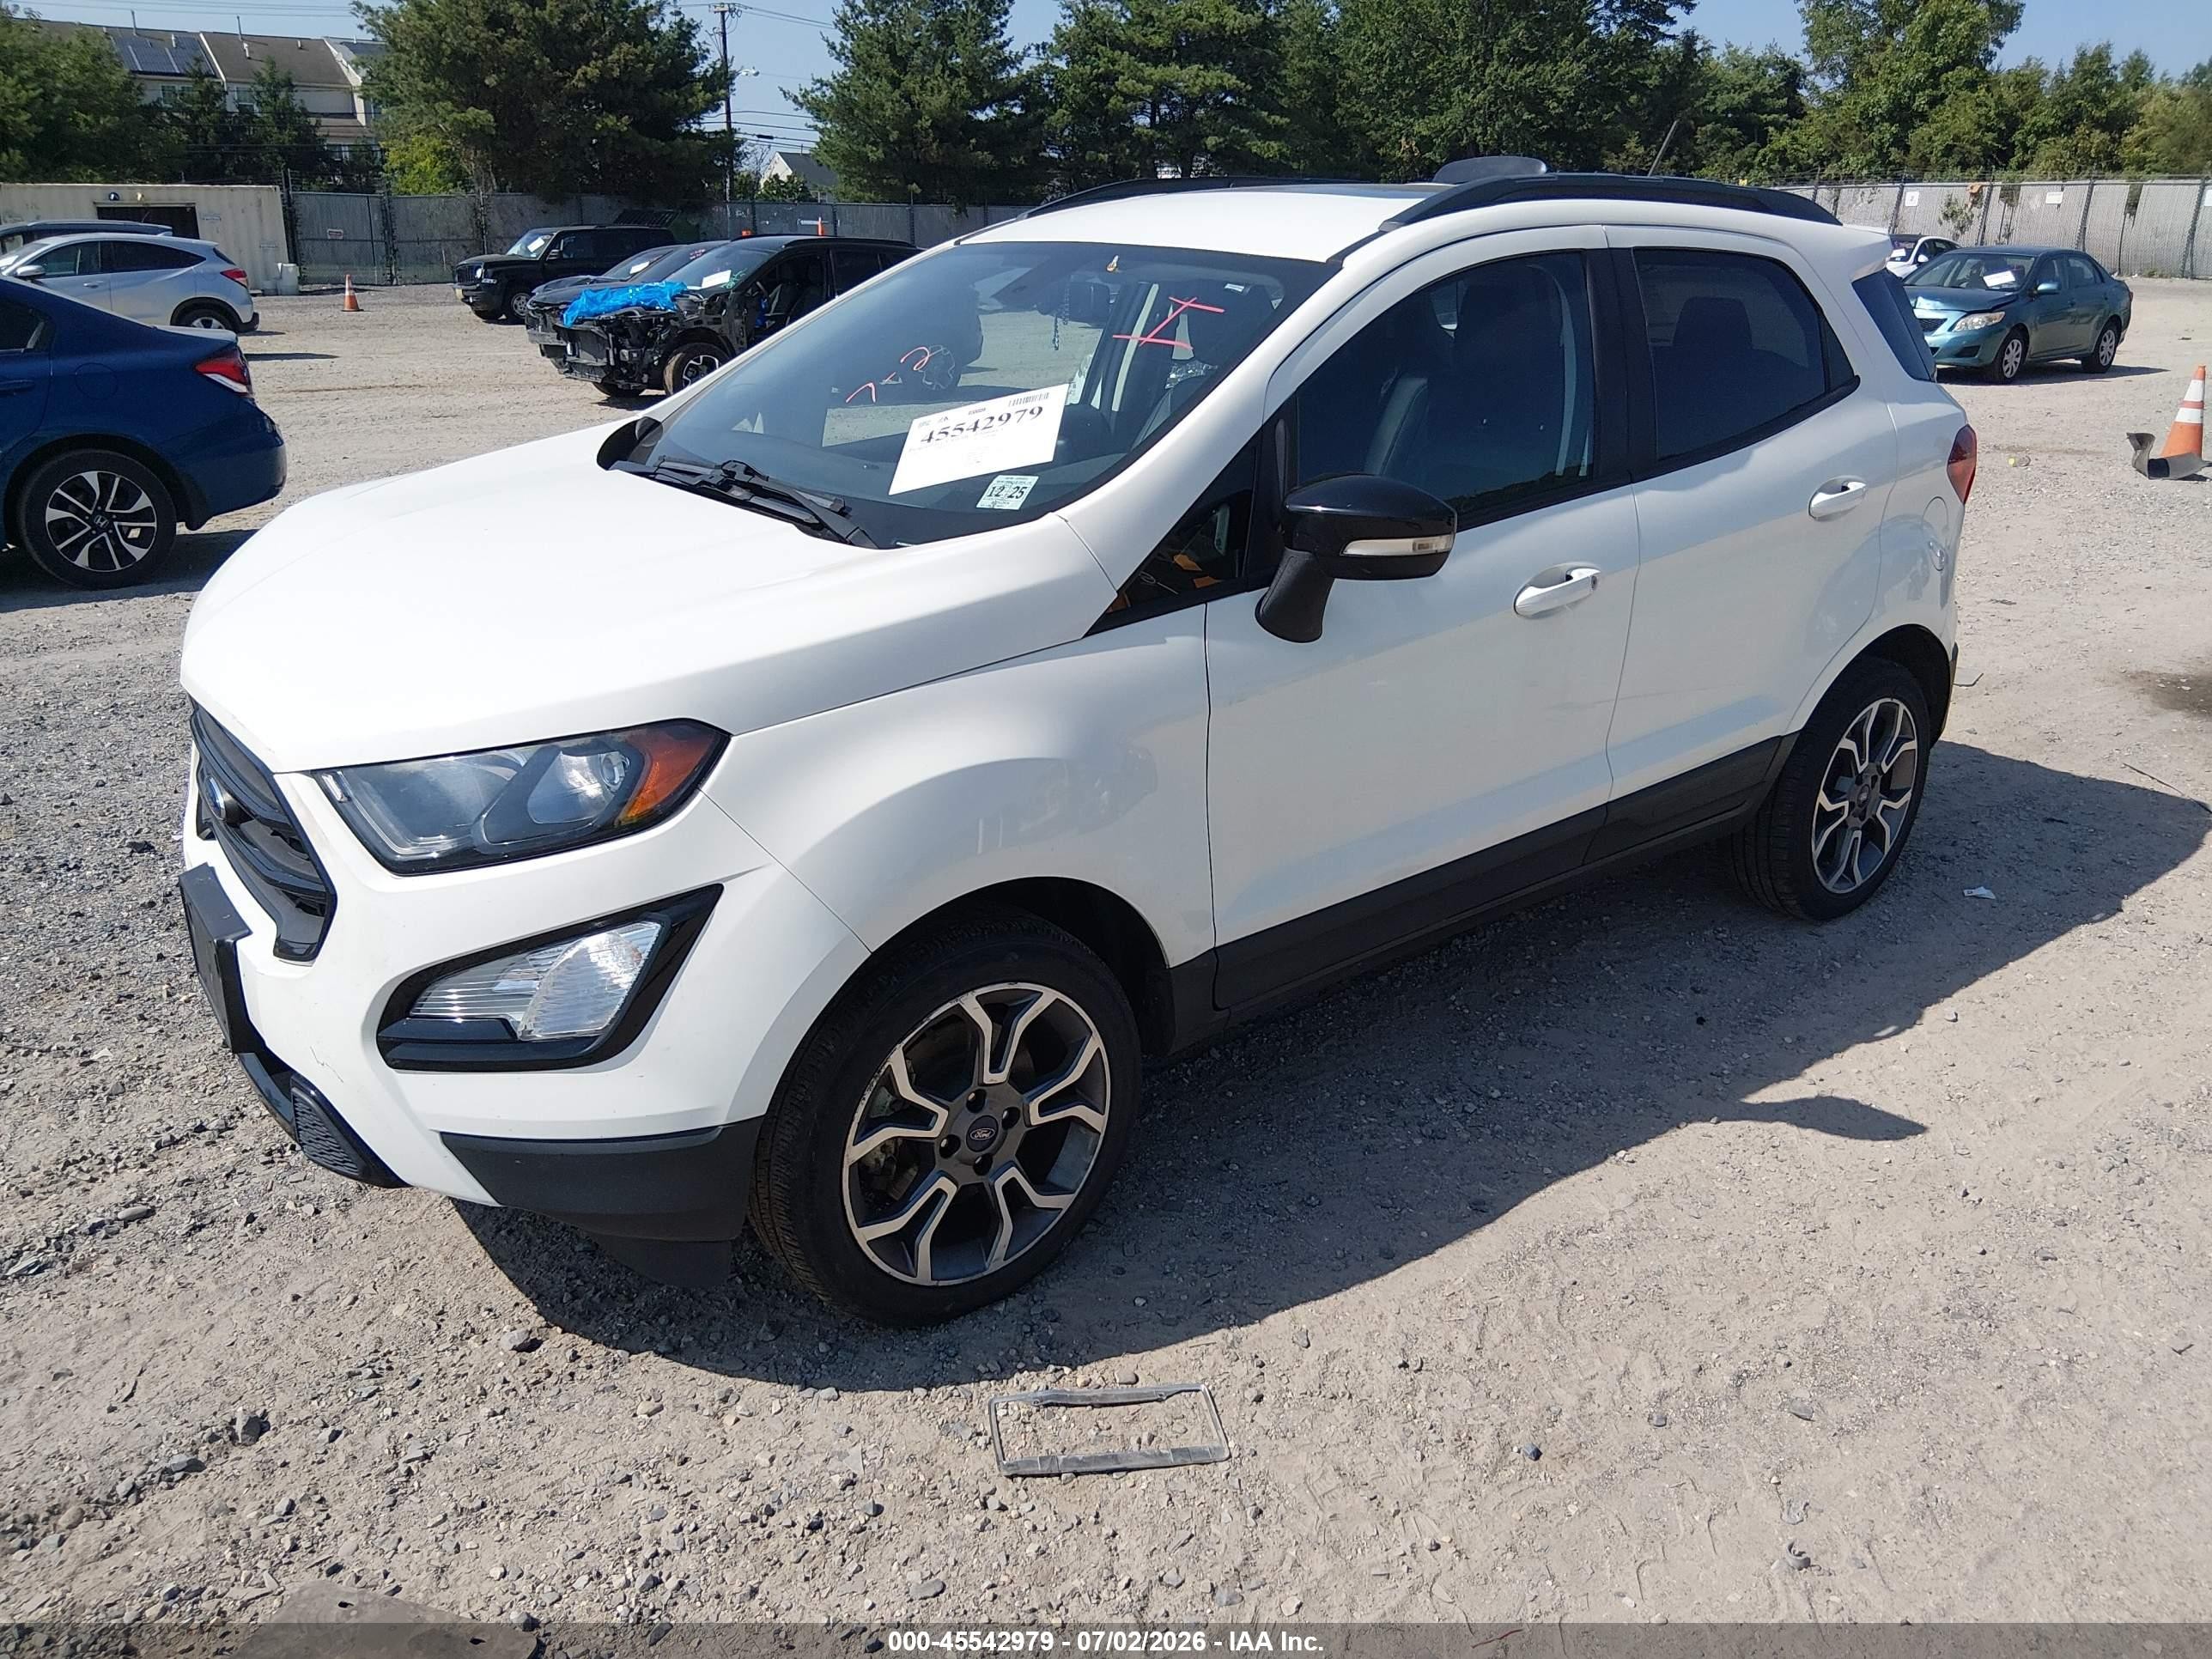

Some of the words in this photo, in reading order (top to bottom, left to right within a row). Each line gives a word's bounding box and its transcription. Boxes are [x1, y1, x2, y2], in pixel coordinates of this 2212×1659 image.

[921, 405, 1044, 444] 45542979
[987, 485, 1006, 497] 12
[1007, 486, 1028, 499] 25
[972, 1127, 994, 1140] Ford
